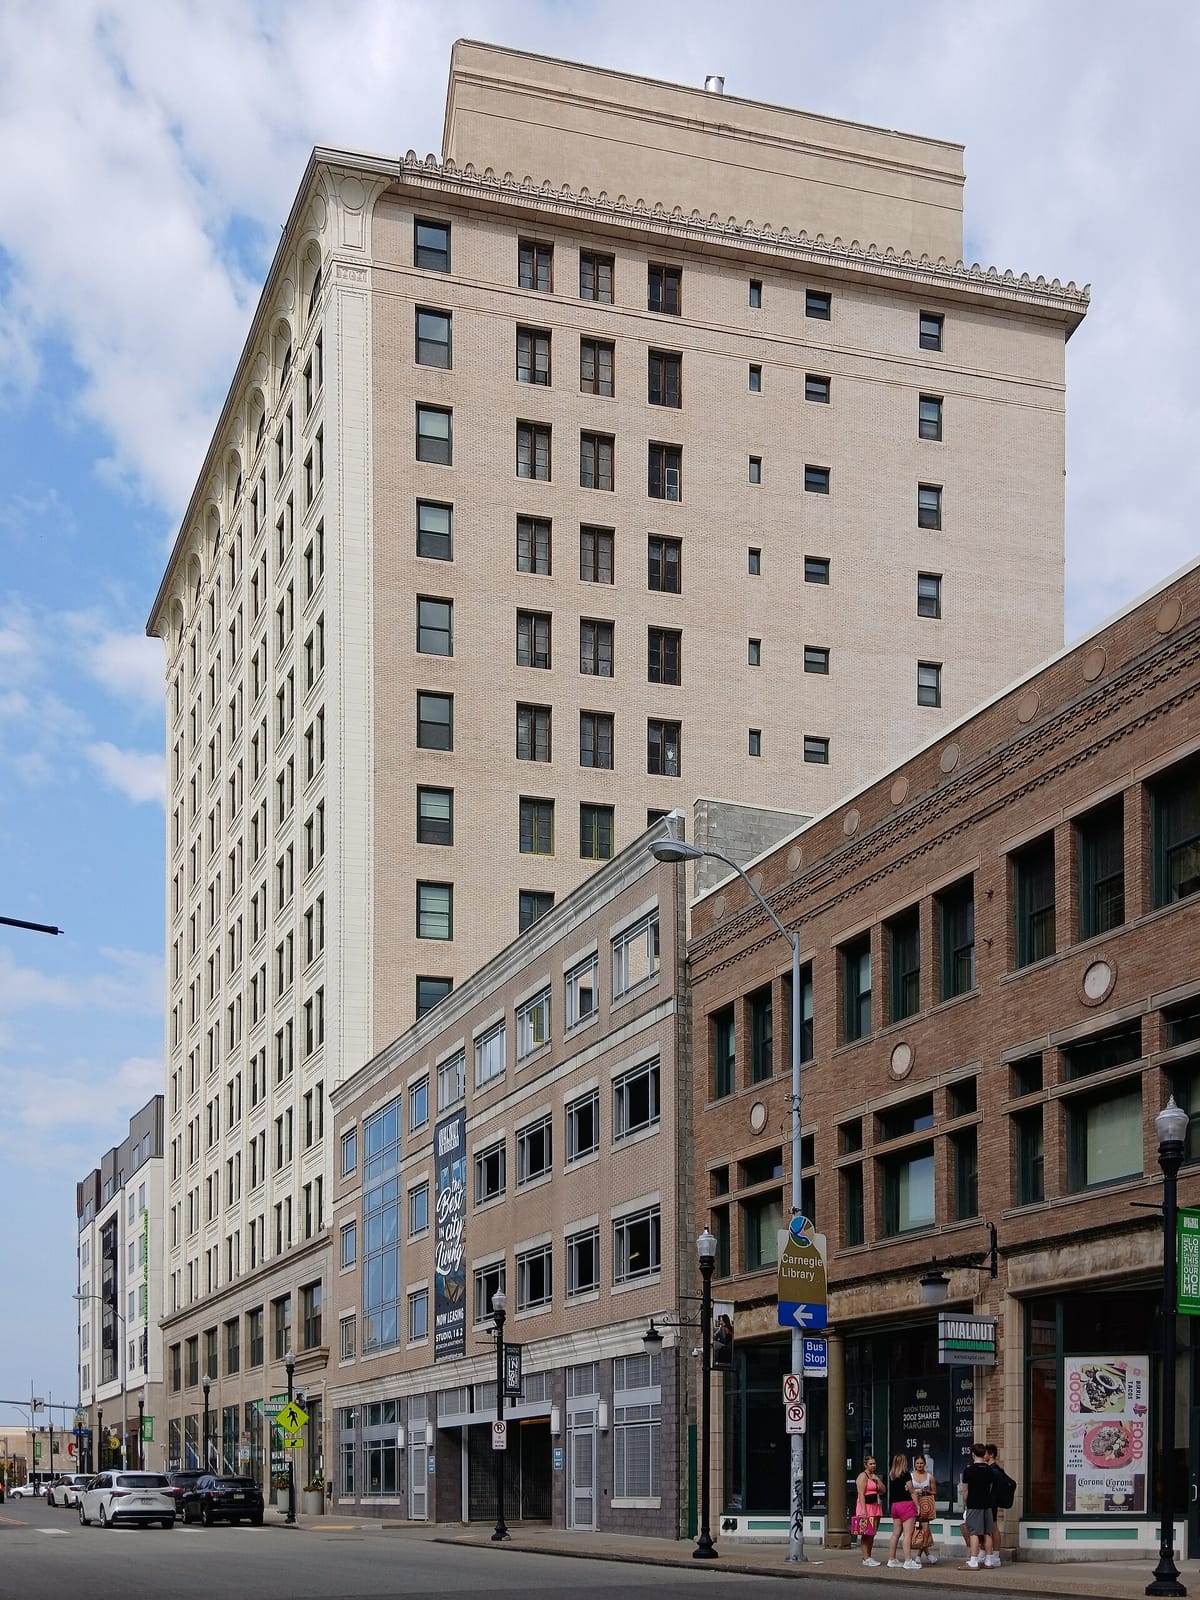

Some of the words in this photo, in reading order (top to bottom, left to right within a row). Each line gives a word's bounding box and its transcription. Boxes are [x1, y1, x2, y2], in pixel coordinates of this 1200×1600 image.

[437, 1187, 463, 1223] Best
[436, 1240, 465, 1275] Living
[782, 1253, 823, 1268] Carnegie
[782, 1267, 815, 1282] Library
[447, 1307, 464, 1323] LEASING
[945, 1321, 994, 1341] WALNUT
[807, 1341, 824, 1351] Bus
[805, 1353, 826, 1364] Stop
[1069, 1372, 1081, 1413] GOOD
[917, 1411, 940, 1420] SHAKER
[903, 1420, 940, 1430] MARGARITA
[906, 1438, 918, 1448] $15
[1132, 1421, 1144, 1459] FOOD
[961, 1447, 971, 1455] $15
[1078, 1478, 1104, 1487] Corona
[1105, 1478, 1133, 1487] Corona
